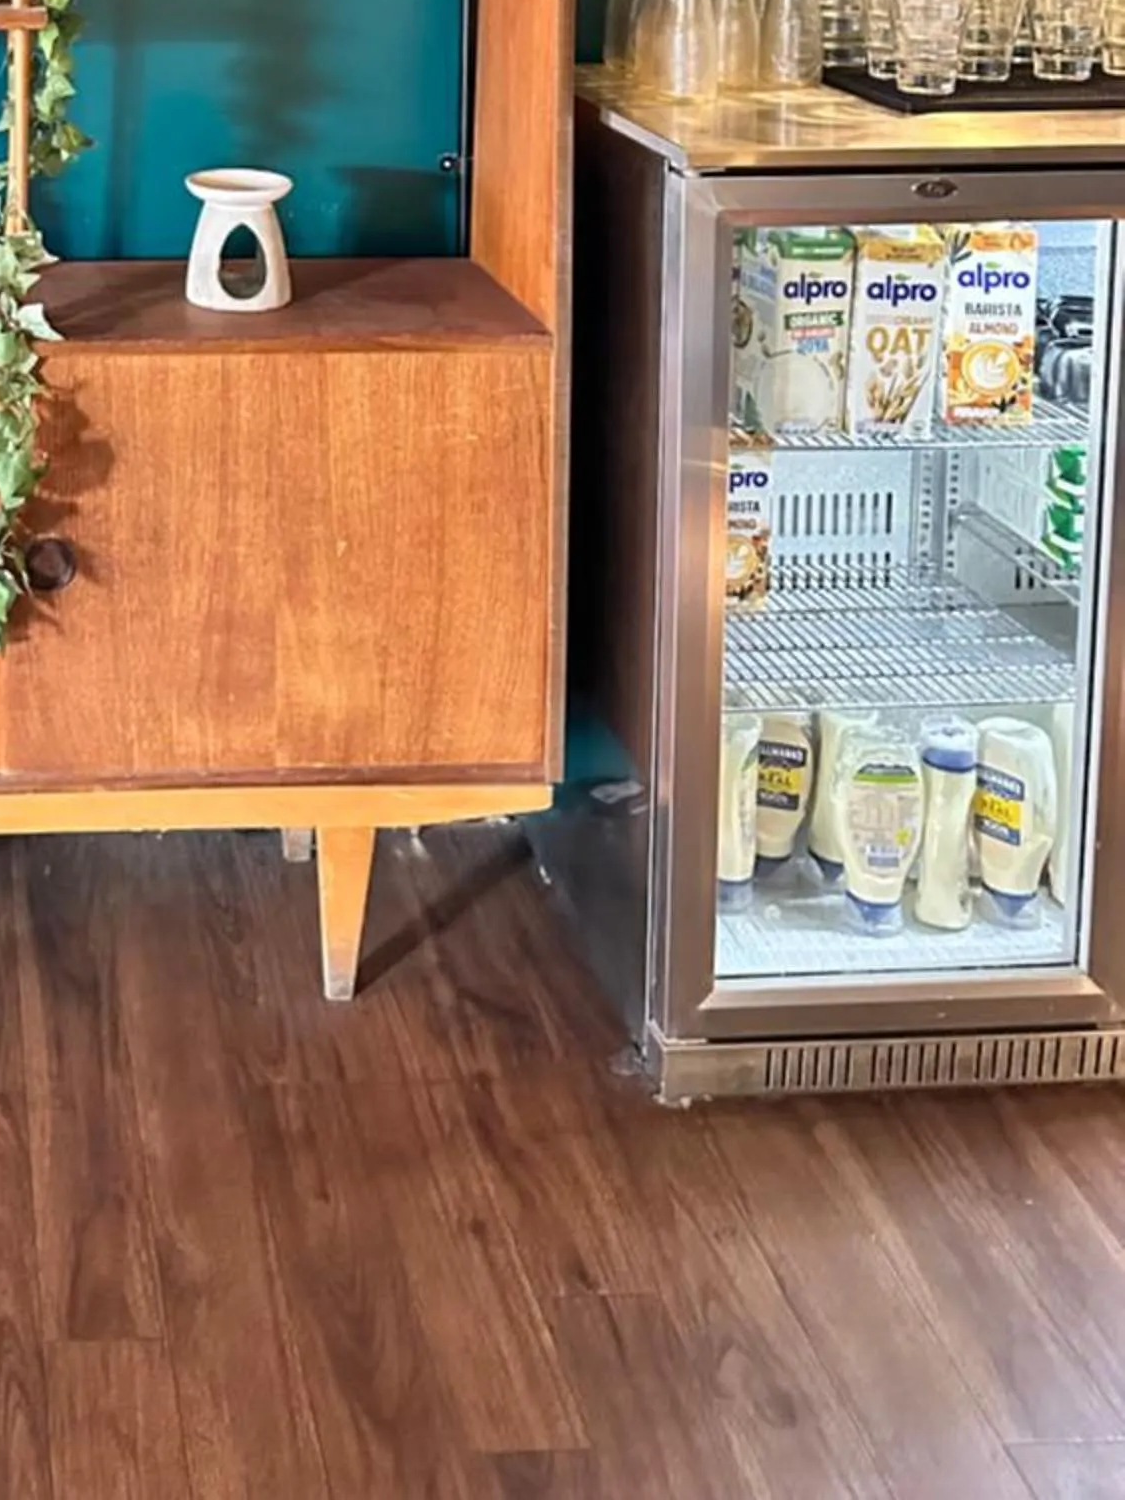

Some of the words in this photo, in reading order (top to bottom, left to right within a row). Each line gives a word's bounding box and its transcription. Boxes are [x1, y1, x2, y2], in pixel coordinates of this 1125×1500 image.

[783, 272, 848, 305] alpro
[866, 274, 938, 308] alpro
[957, 262, 1031, 295] alpro
[964, 302, 1023, 317] BARISTA
[729, 471, 769, 494] pro
[728, 500, 761, 514] RISTA
